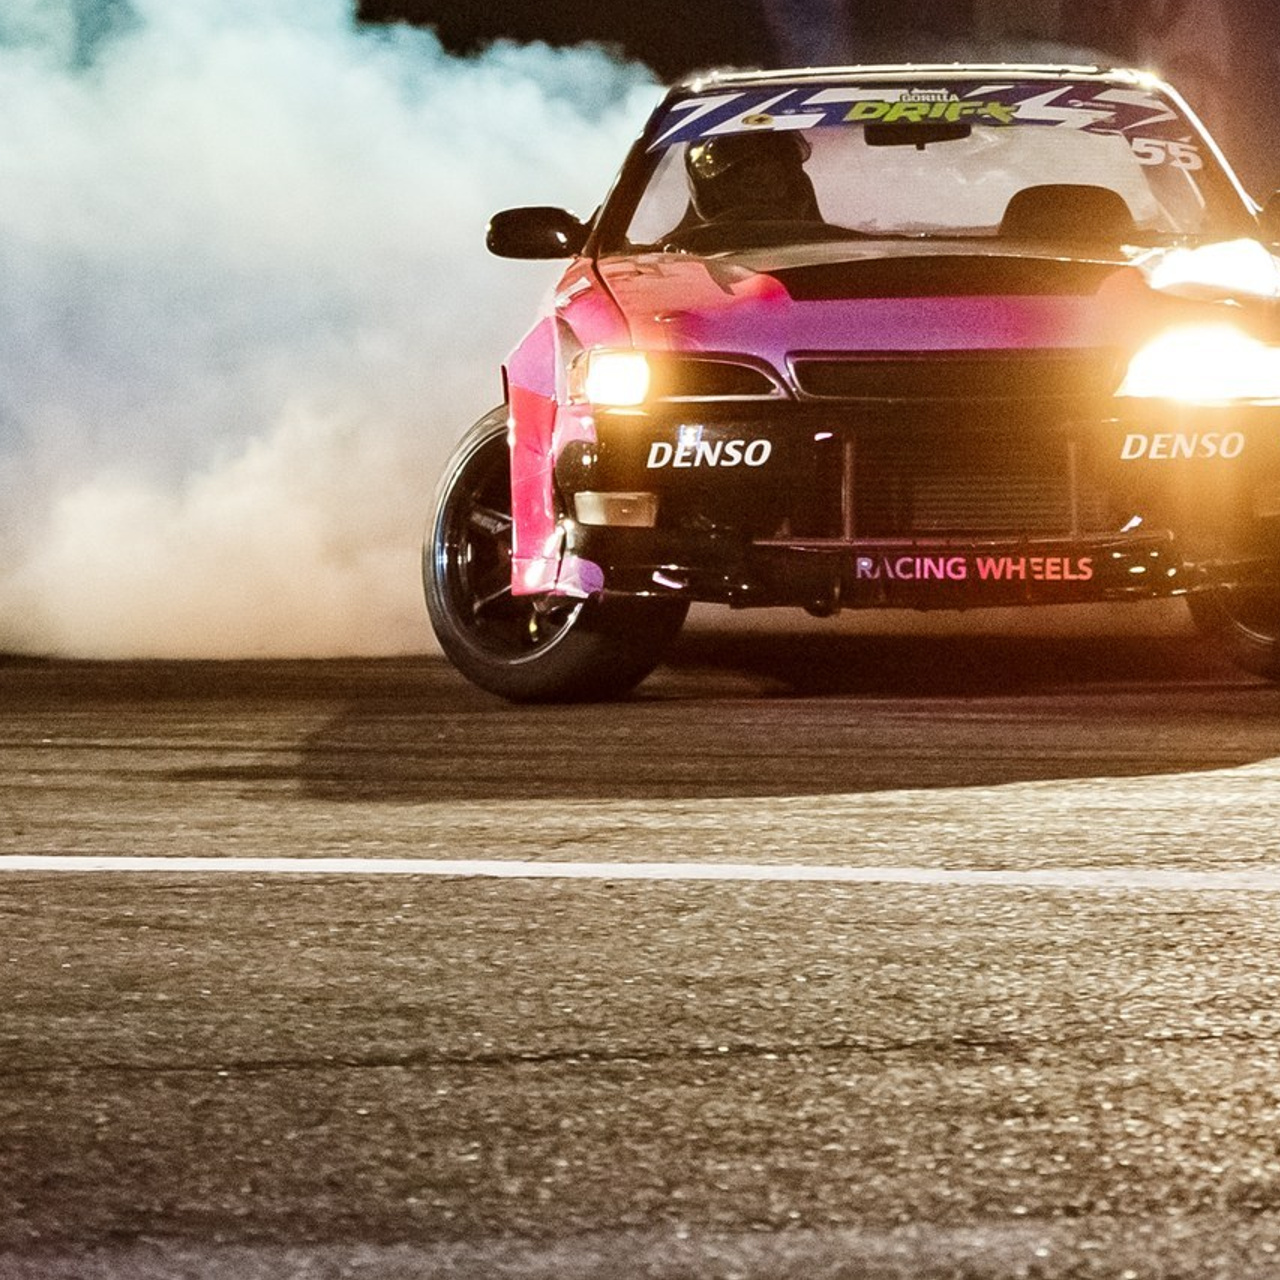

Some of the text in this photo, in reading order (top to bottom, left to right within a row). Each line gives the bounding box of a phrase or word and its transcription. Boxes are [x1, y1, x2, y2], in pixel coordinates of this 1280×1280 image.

[1131, 137, 1203, 170] 55
[646, 439, 772, 469] DENSO
[1120, 431, 1245, 460] DENSO
[856, 557, 1093, 581] RACING WHEELS
